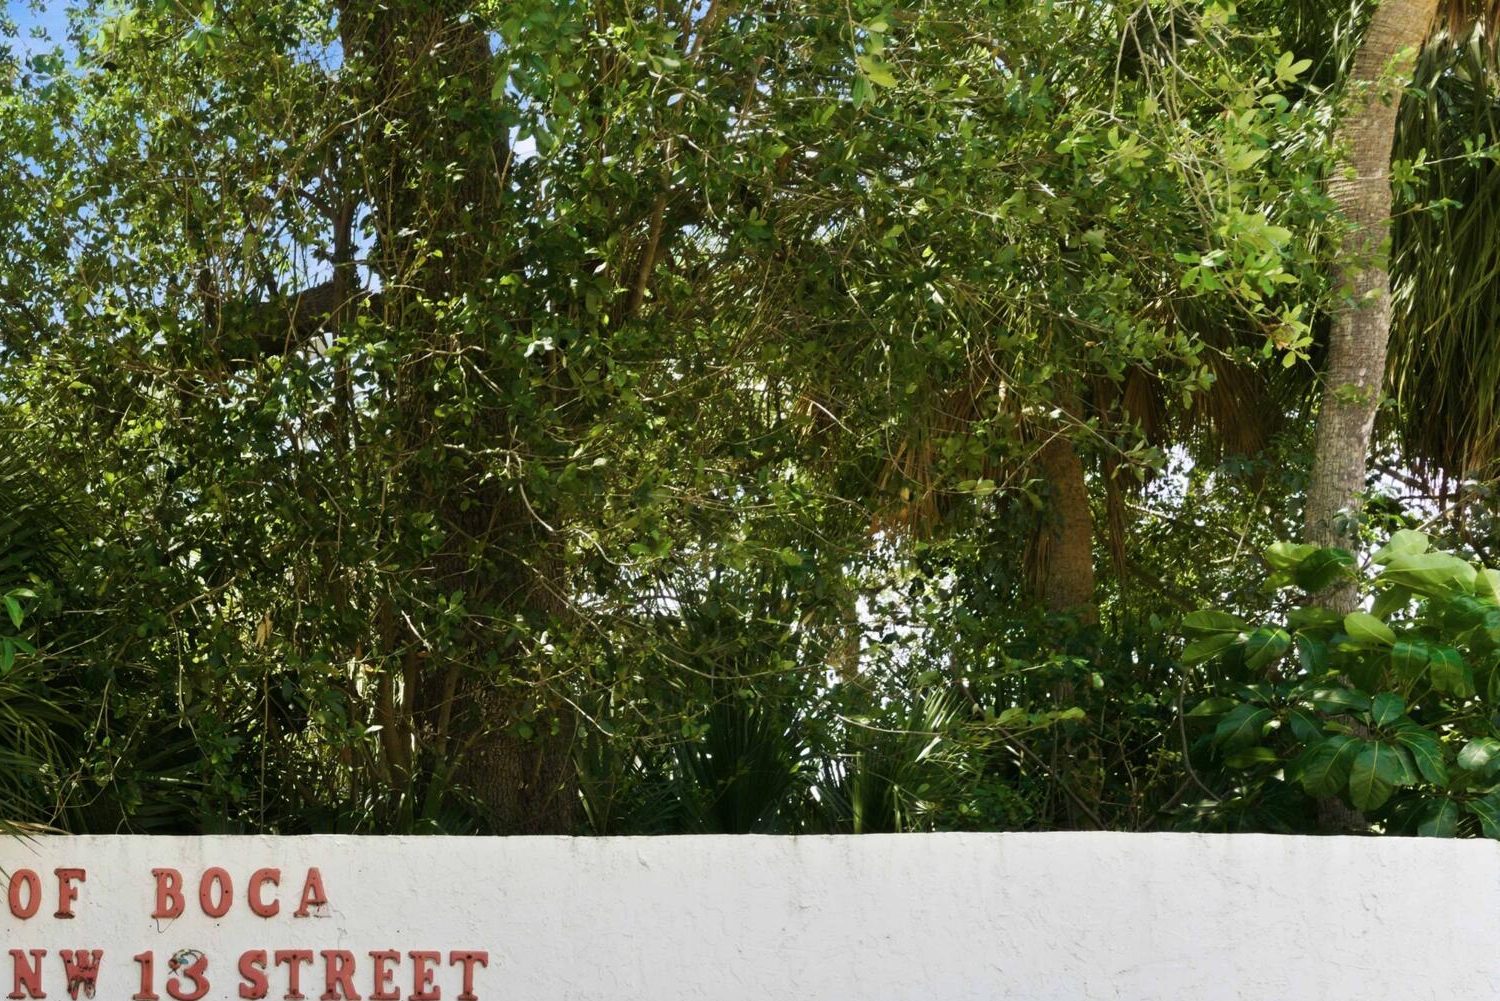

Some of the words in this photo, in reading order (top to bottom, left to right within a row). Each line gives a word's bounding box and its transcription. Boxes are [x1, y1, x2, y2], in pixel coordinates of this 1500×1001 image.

[7, 867, 87, 919] OF
[152, 866, 327, 919] BOCA
[9, 948, 104, 1001] NW
[134, 947, 210, 1001] 13
[238, 948, 490, 1001] STREET
